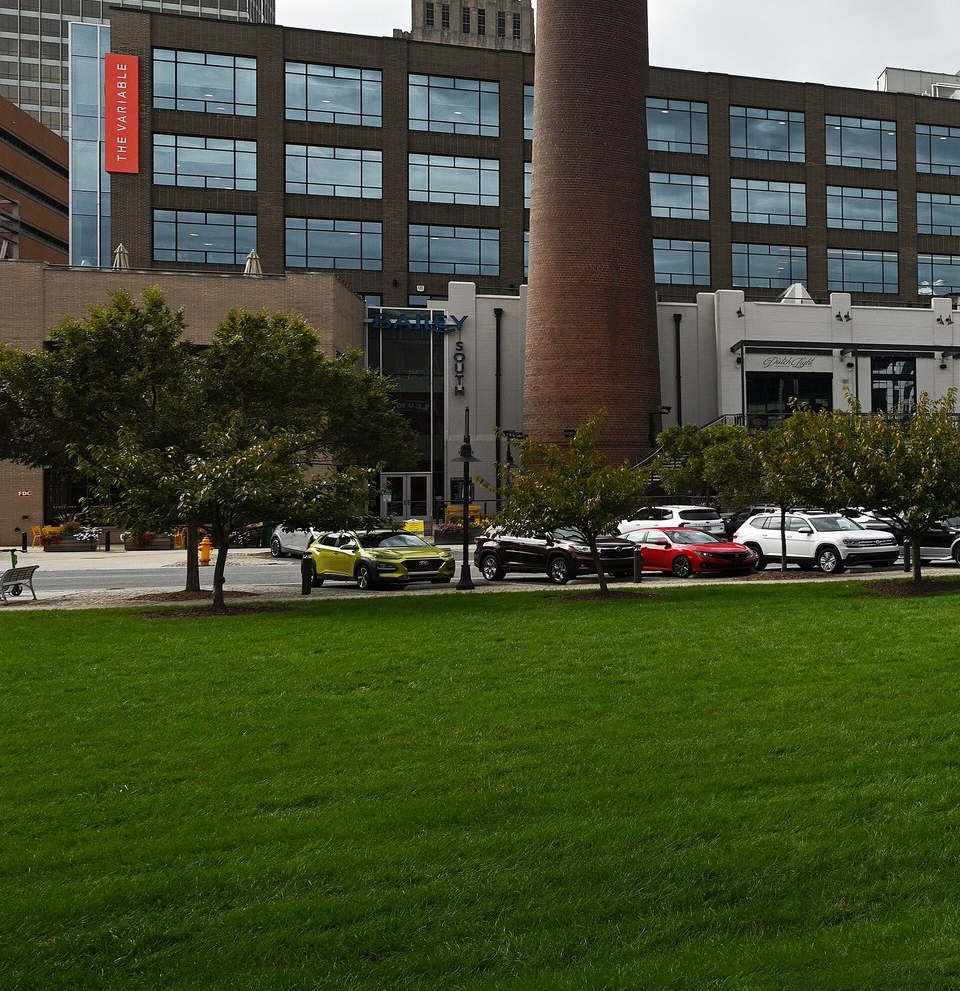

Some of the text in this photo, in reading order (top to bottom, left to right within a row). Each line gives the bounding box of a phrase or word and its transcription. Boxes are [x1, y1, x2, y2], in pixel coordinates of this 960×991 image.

[117, 64, 127, 161] THE VARIABLE
[372, 312, 468, 332] BAILEY
[453, 341, 466, 396] SOUTH
